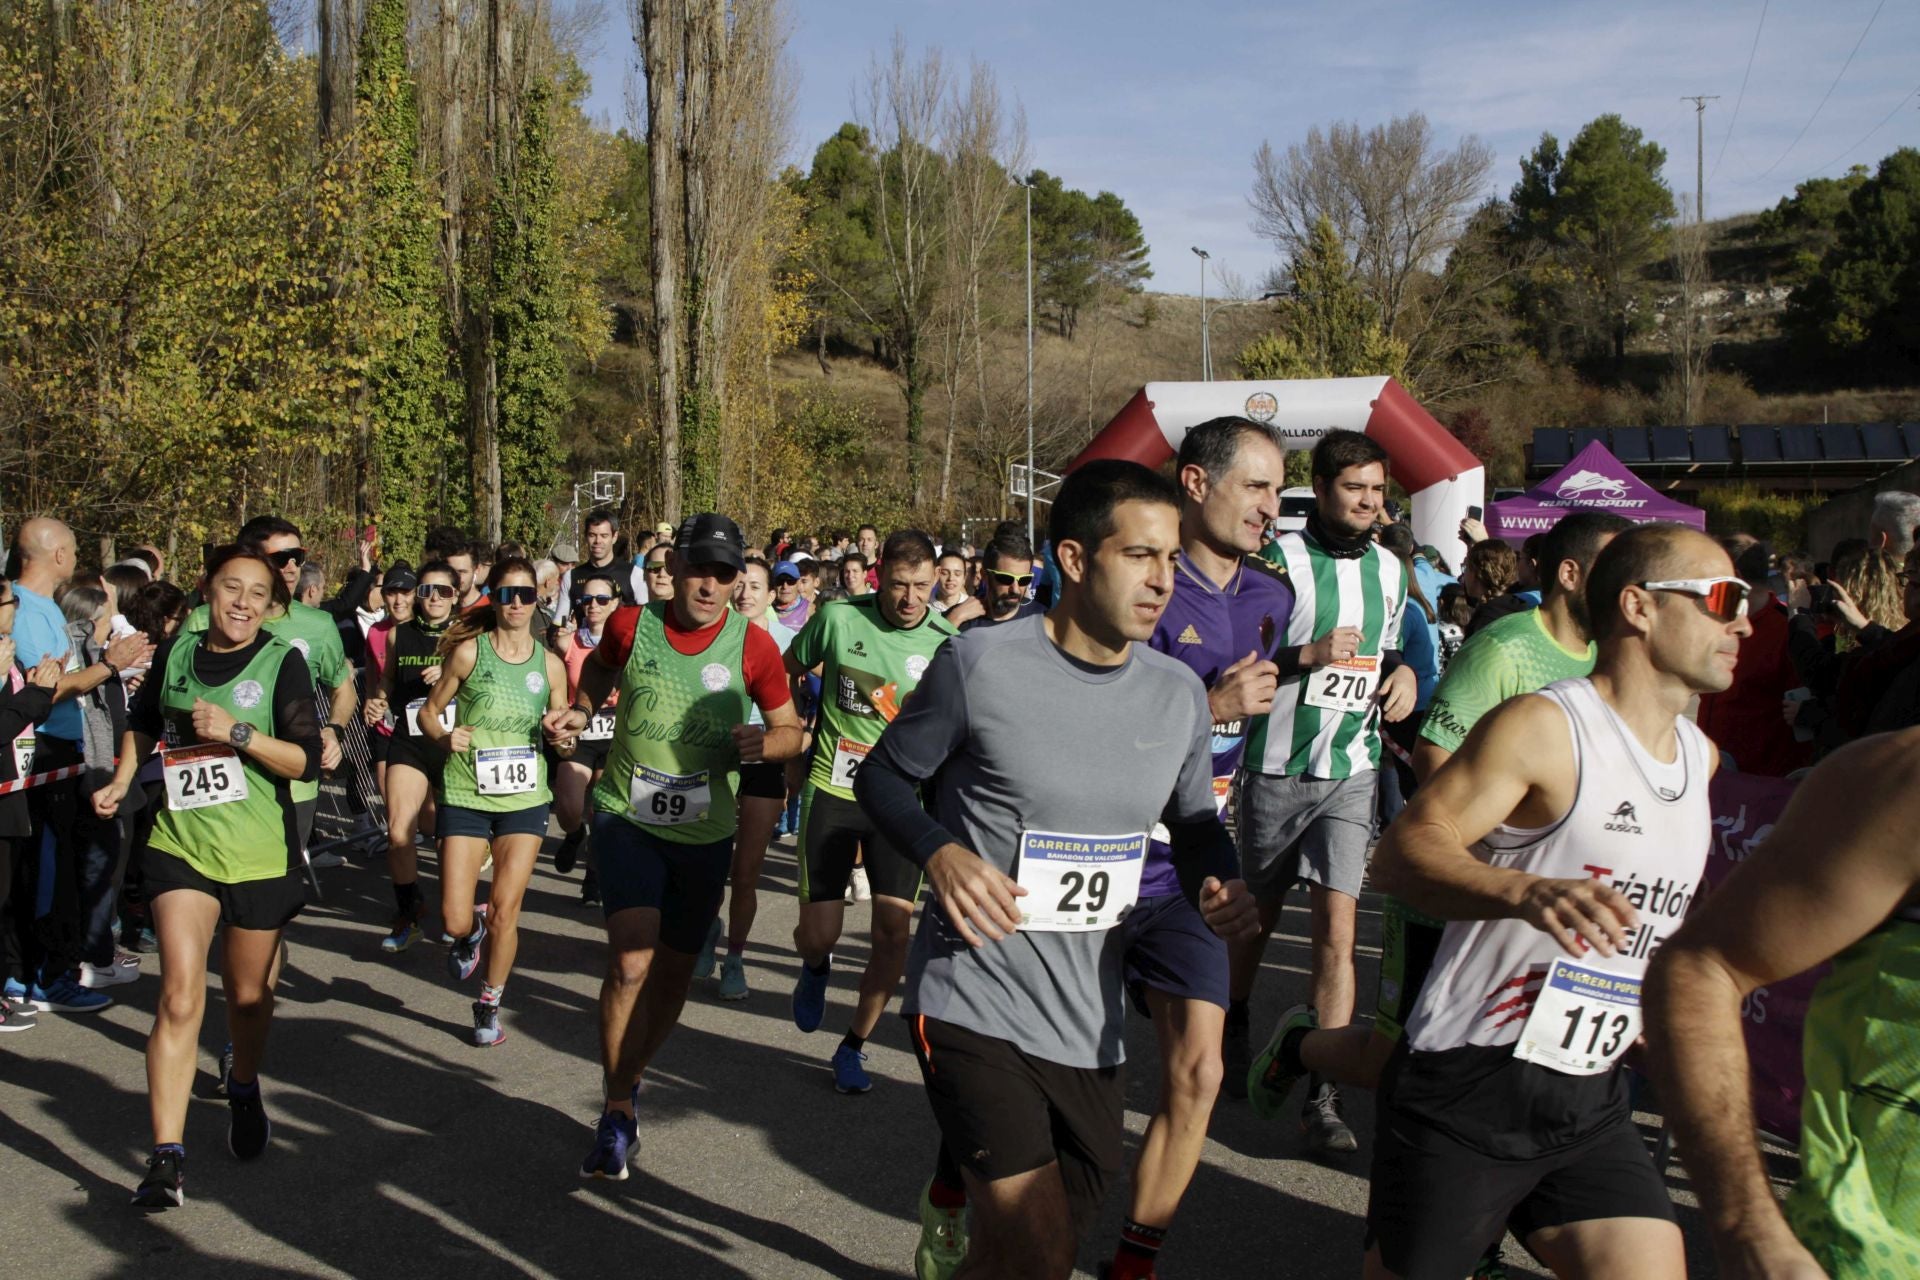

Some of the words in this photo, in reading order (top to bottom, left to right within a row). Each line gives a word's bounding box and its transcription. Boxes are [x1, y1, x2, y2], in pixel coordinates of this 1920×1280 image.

[1279, 427, 1328, 438] ALLADO
[1538, 499, 1648, 508] RUNVASPORT
[1323, 672, 1367, 701] 270
[179, 763, 230, 797] 245
[490, 763, 527, 785] 148
[651, 791, 686, 817] 69
[1603, 822, 1644, 836] austral
[1028, 838, 1090, 853] CARRERA
[1094, 840, 1141, 853] POPULAR
[1084, 853, 1094, 862] DE
[1056, 870, 1110, 913] 29
[1556, 967, 1612, 991] CARRERA
[1560, 1005, 1630, 1057] 113
